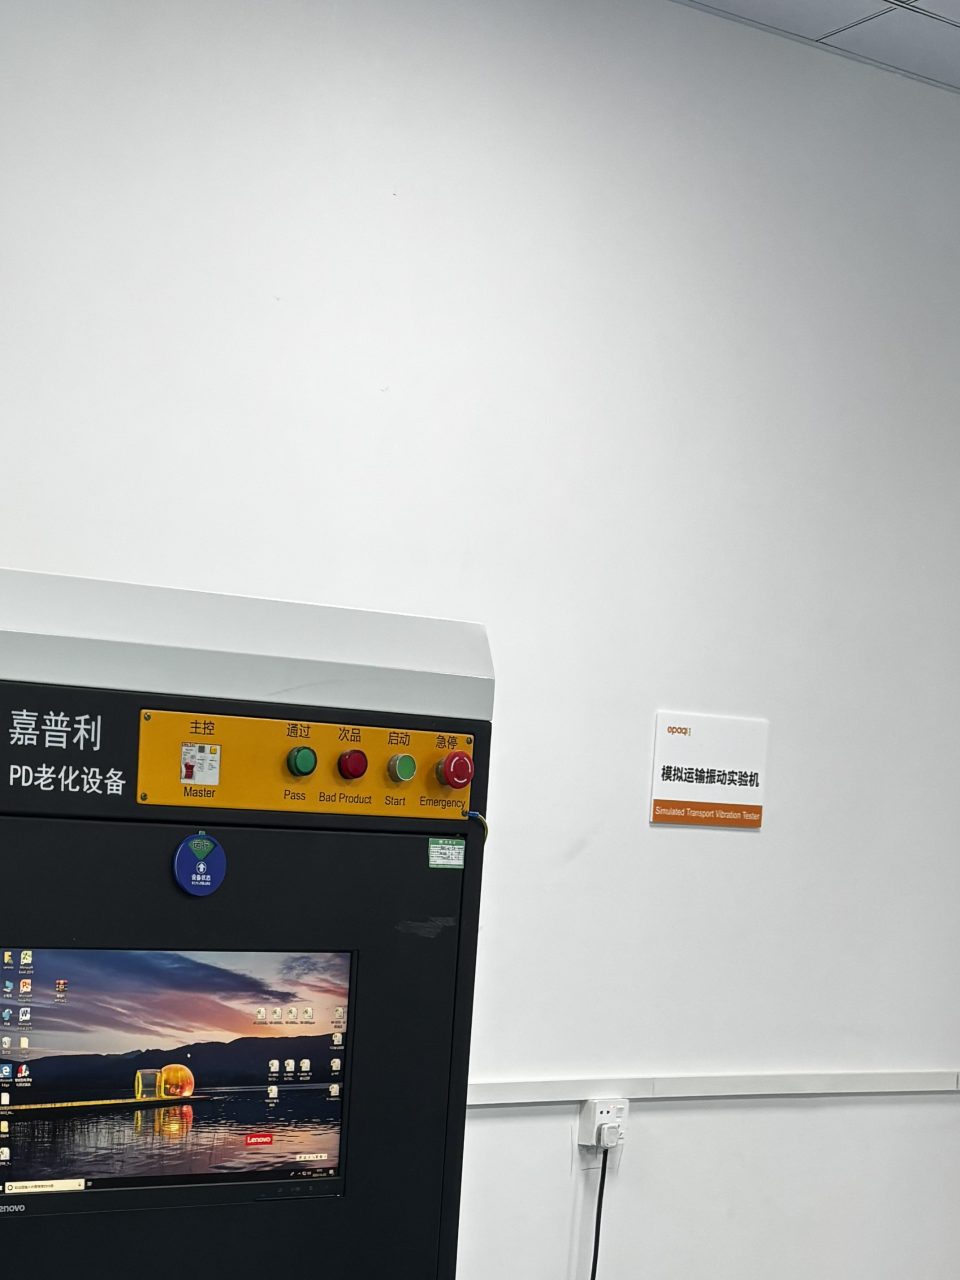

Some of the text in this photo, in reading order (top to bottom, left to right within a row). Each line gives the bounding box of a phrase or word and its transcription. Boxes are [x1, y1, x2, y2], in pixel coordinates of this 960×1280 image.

[8, 708, 102, 751] 嘉普利
[189, 720, 215, 736] 主控
[286, 723, 311, 739] 通过
[338, 727, 362, 743] 次品
[387, 731, 411, 747] 启动
[435, 735, 458, 750] 急停
[9, 763, 127, 796] PD老化设备
[661, 765, 760, 787] 模拟运输振动实验机
[183, 786, 216, 799] Master
[283, 789, 306, 801] Pass
[319, 792, 372, 805] Bad Product
[384, 796, 406, 807] Start
[419, 796, 466, 809] Emergency
[655, 806, 760, 820] Simulated Transport Vibration Tester
[246, 1136, 271, 1144] Lenovo
